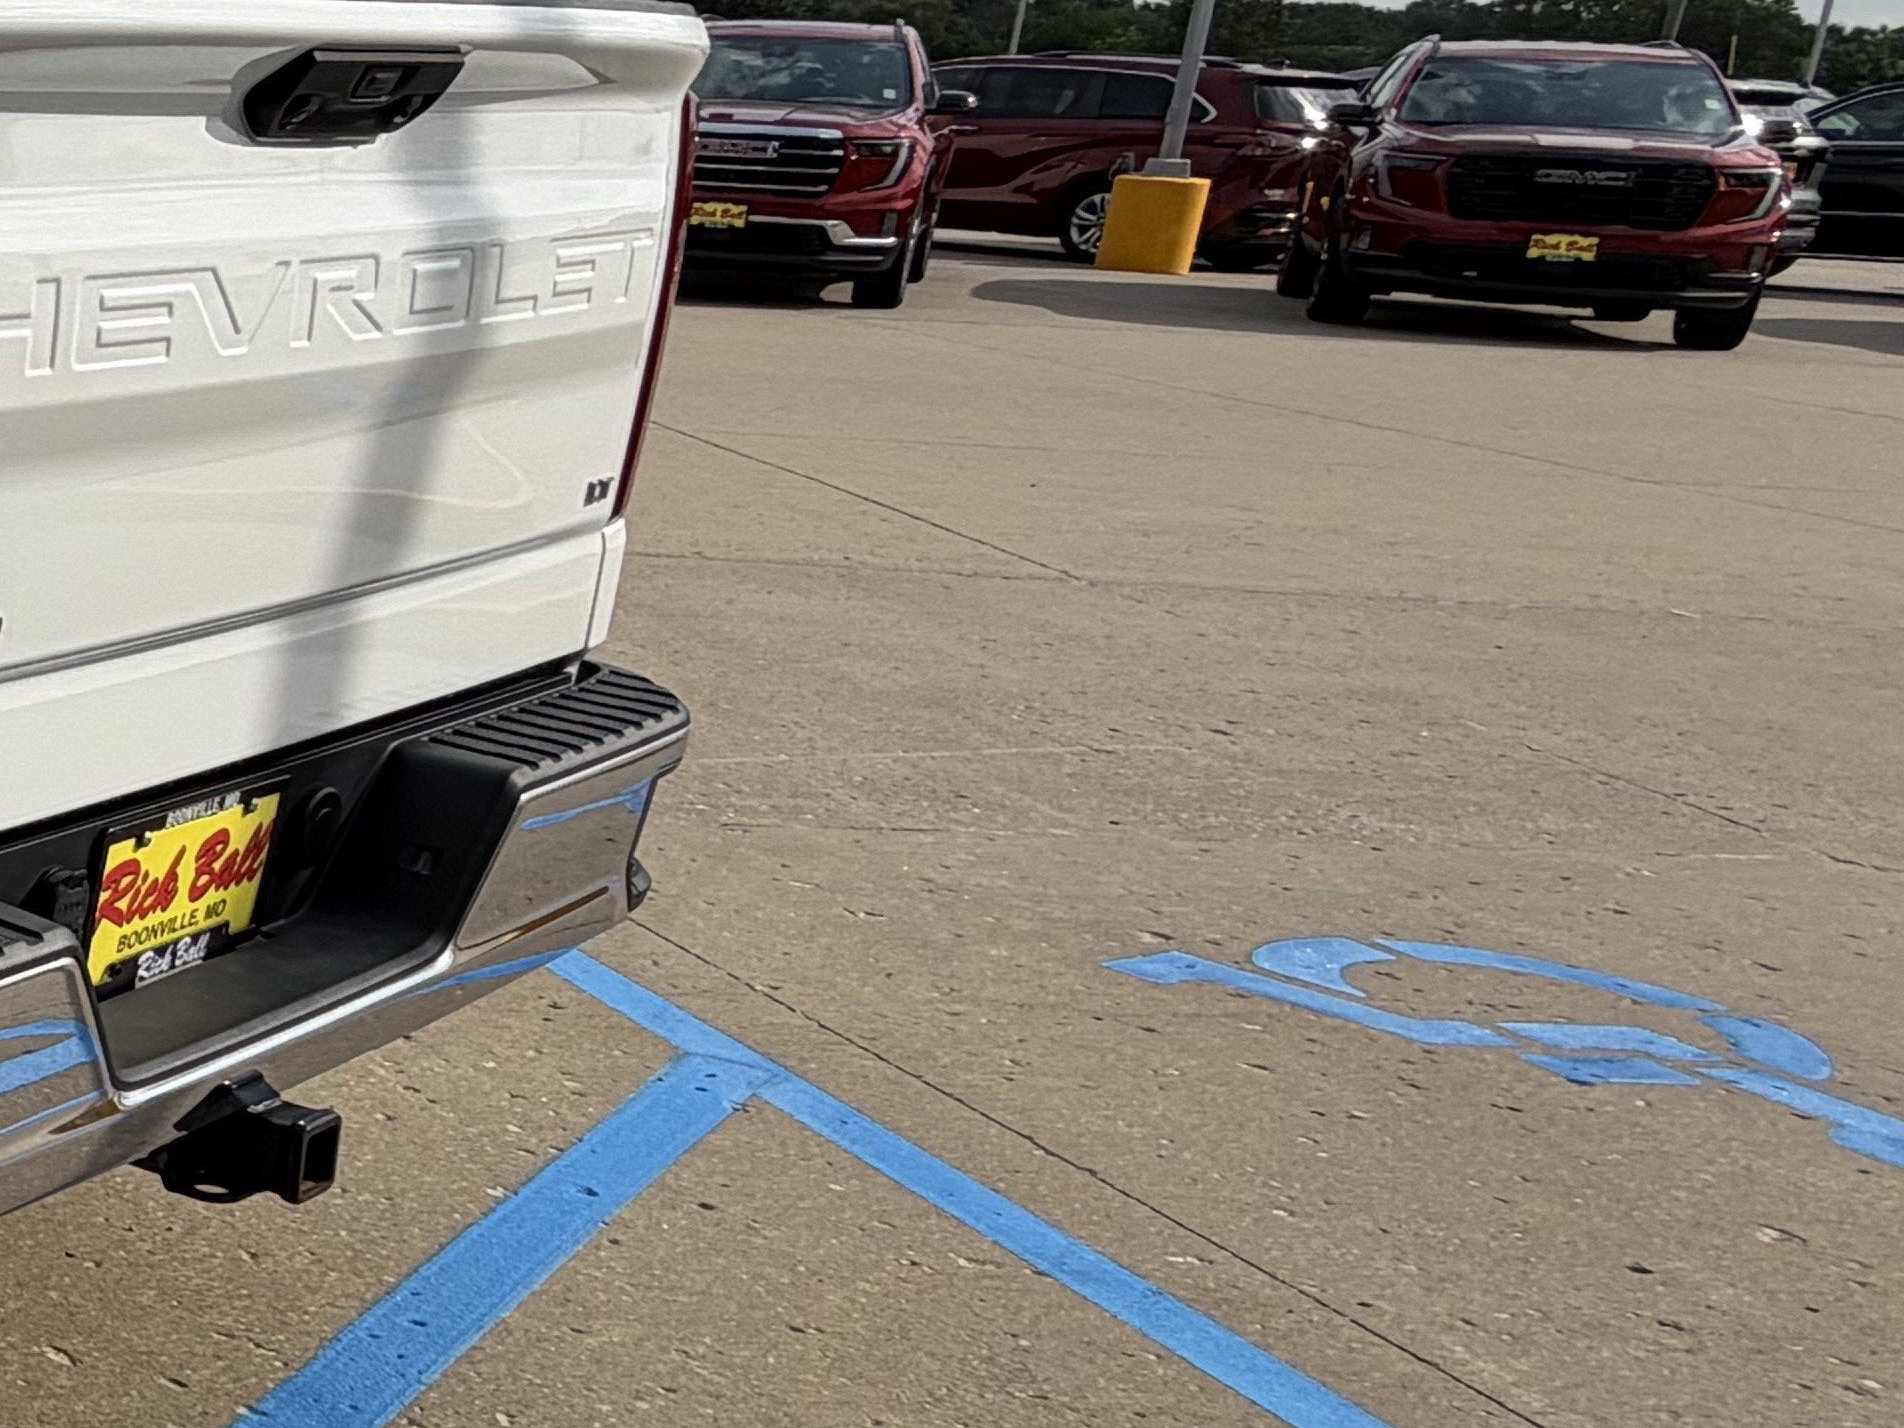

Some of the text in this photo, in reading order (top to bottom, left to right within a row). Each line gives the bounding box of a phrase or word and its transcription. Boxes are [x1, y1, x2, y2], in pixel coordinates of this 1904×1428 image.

[95, 822, 274, 927] Rick Ball
[116, 899, 228, 953] BOONVILLE, MO
